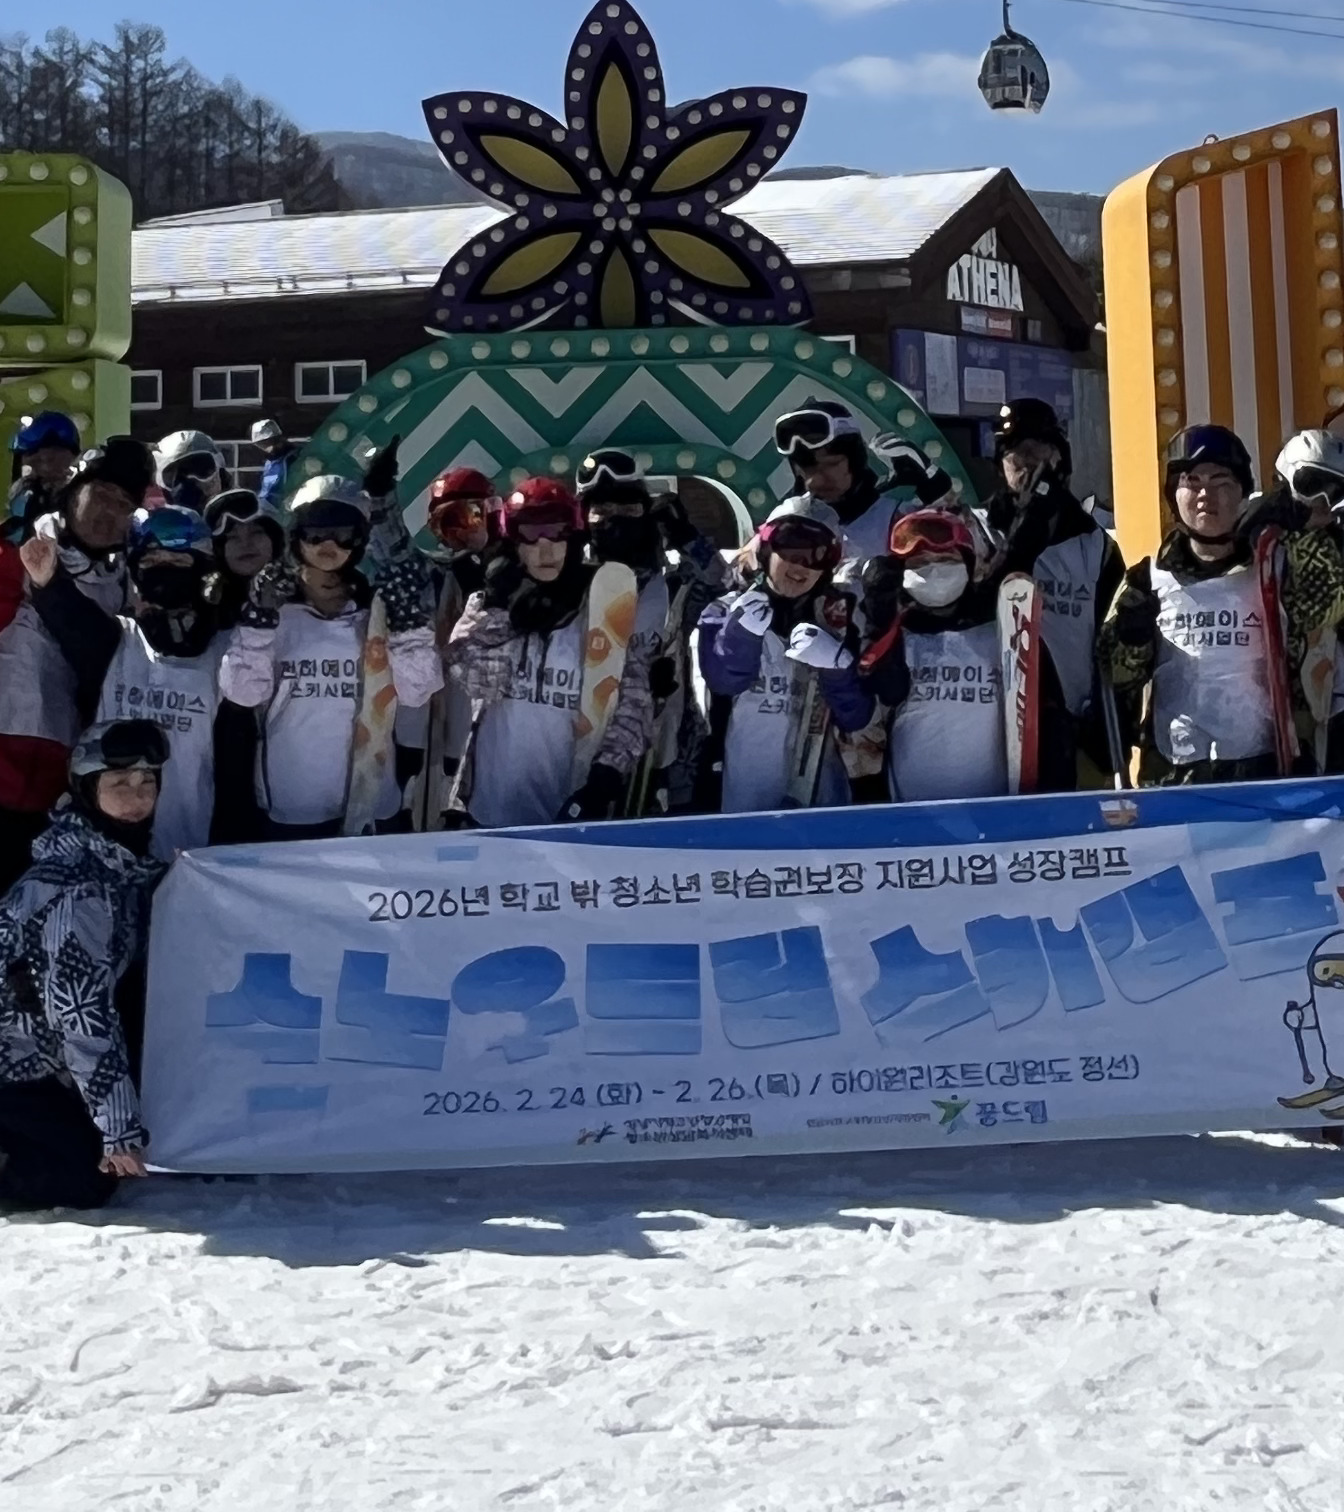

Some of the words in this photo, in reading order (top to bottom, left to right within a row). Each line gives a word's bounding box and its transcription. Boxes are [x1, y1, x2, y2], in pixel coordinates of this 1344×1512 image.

[947, 254, 1024, 312] ATHENA
[368, 885, 491, 923] 2026년
[500, 882, 561, 913] 학교
[570, 878, 600, 910] 밖
[609, 872, 701, 908] 청소년
[711, 862, 864, 900] 학습권보장
[875, 854, 998, 891] 지원사업
[1007, 846, 1133, 883] 성장캠프
[808, 1072, 823, 1096] /
[1078, 1053, 1141, 1083] 정선)
